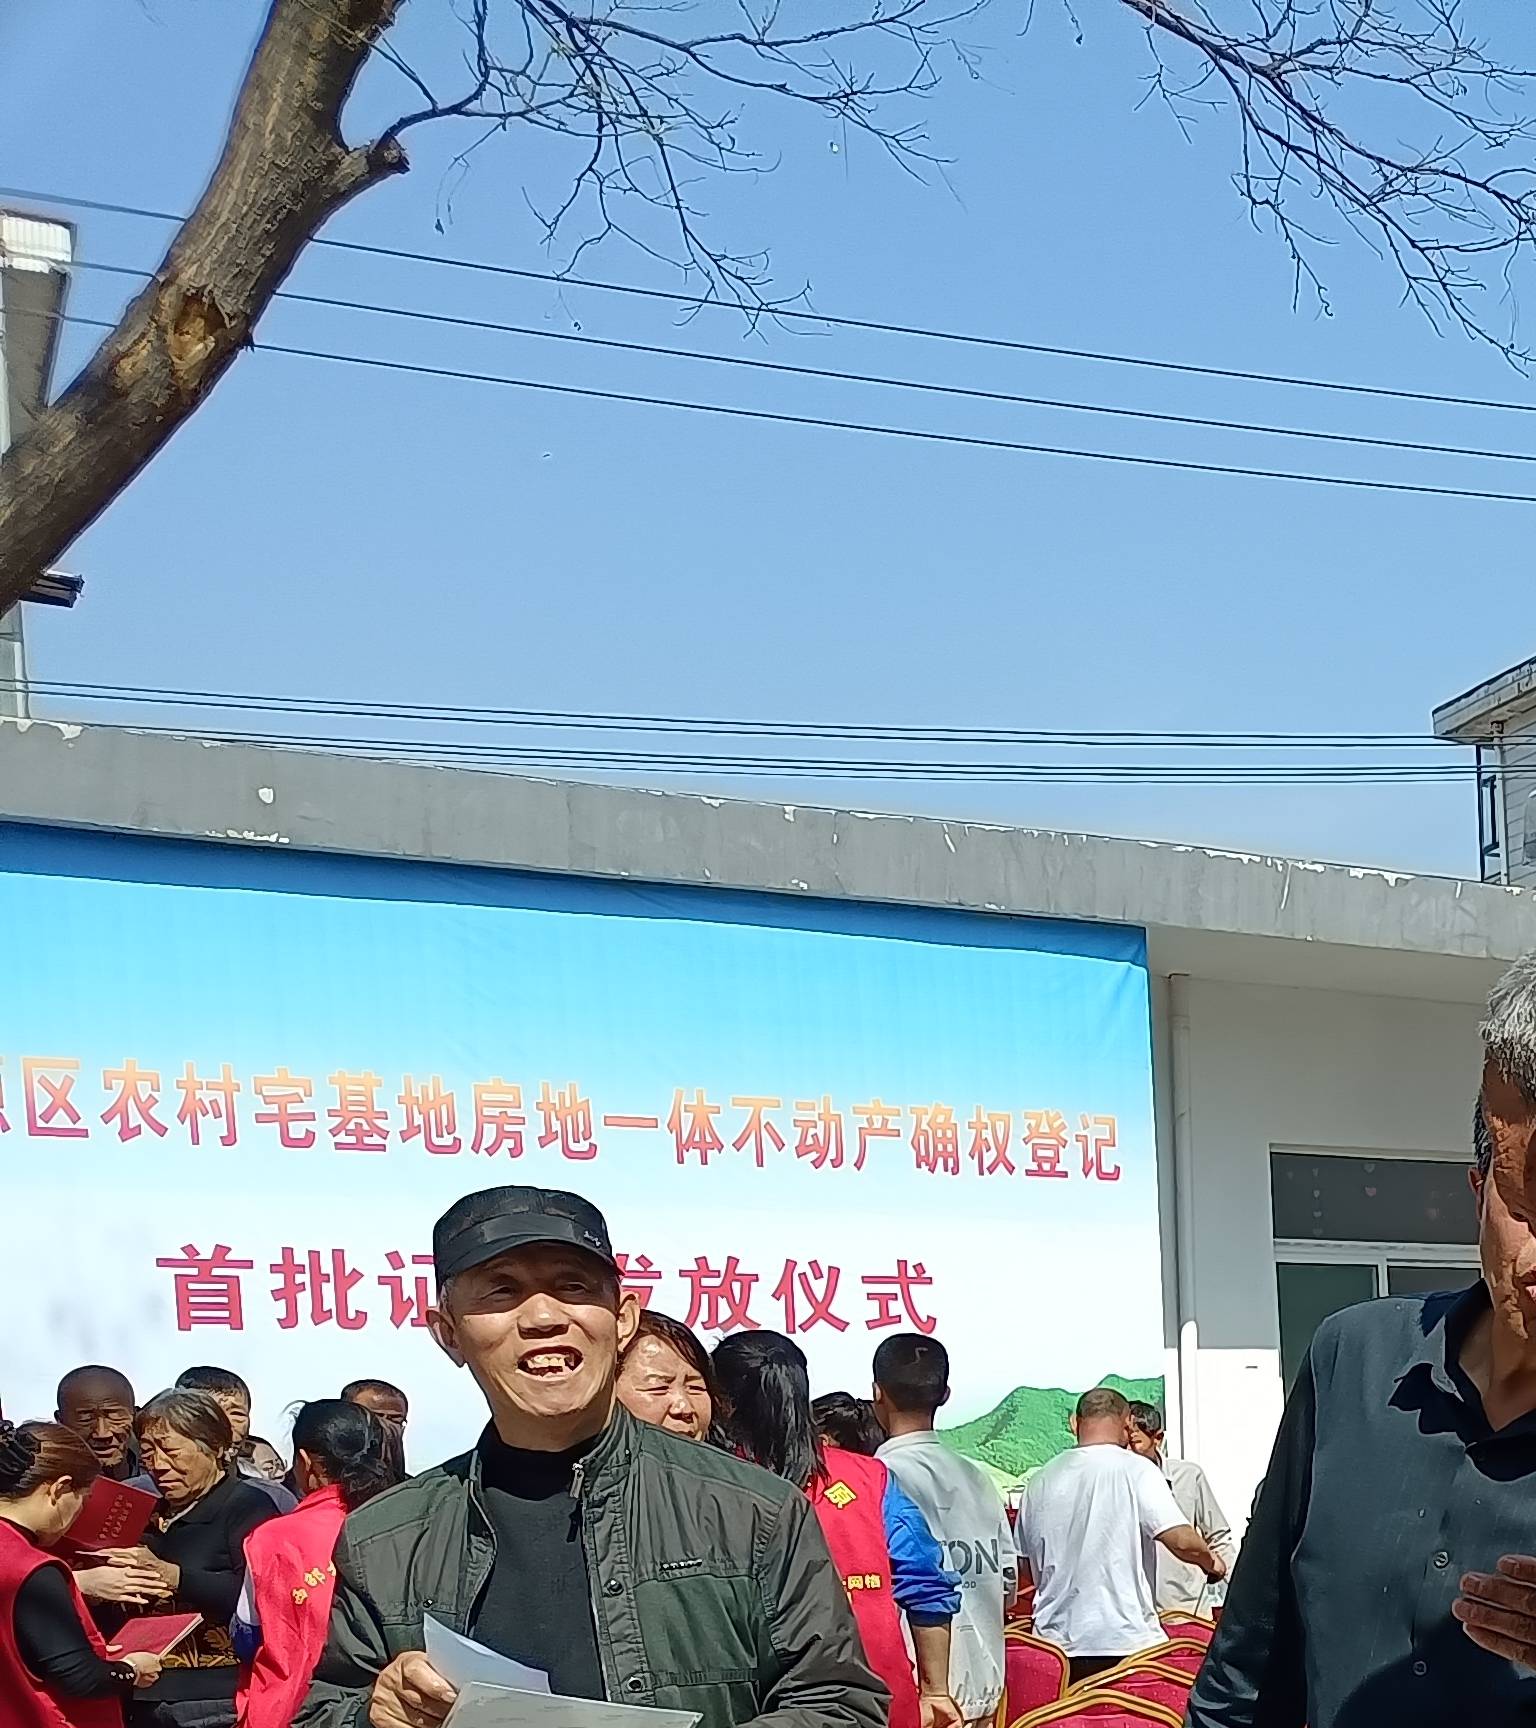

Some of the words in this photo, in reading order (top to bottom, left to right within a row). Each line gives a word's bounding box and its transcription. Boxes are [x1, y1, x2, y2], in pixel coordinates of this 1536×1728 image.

[0, 1056, 1122, 1181] 区农村宅基地房地一体不动产确权登记
[938, 1537, 999, 1576] ON
